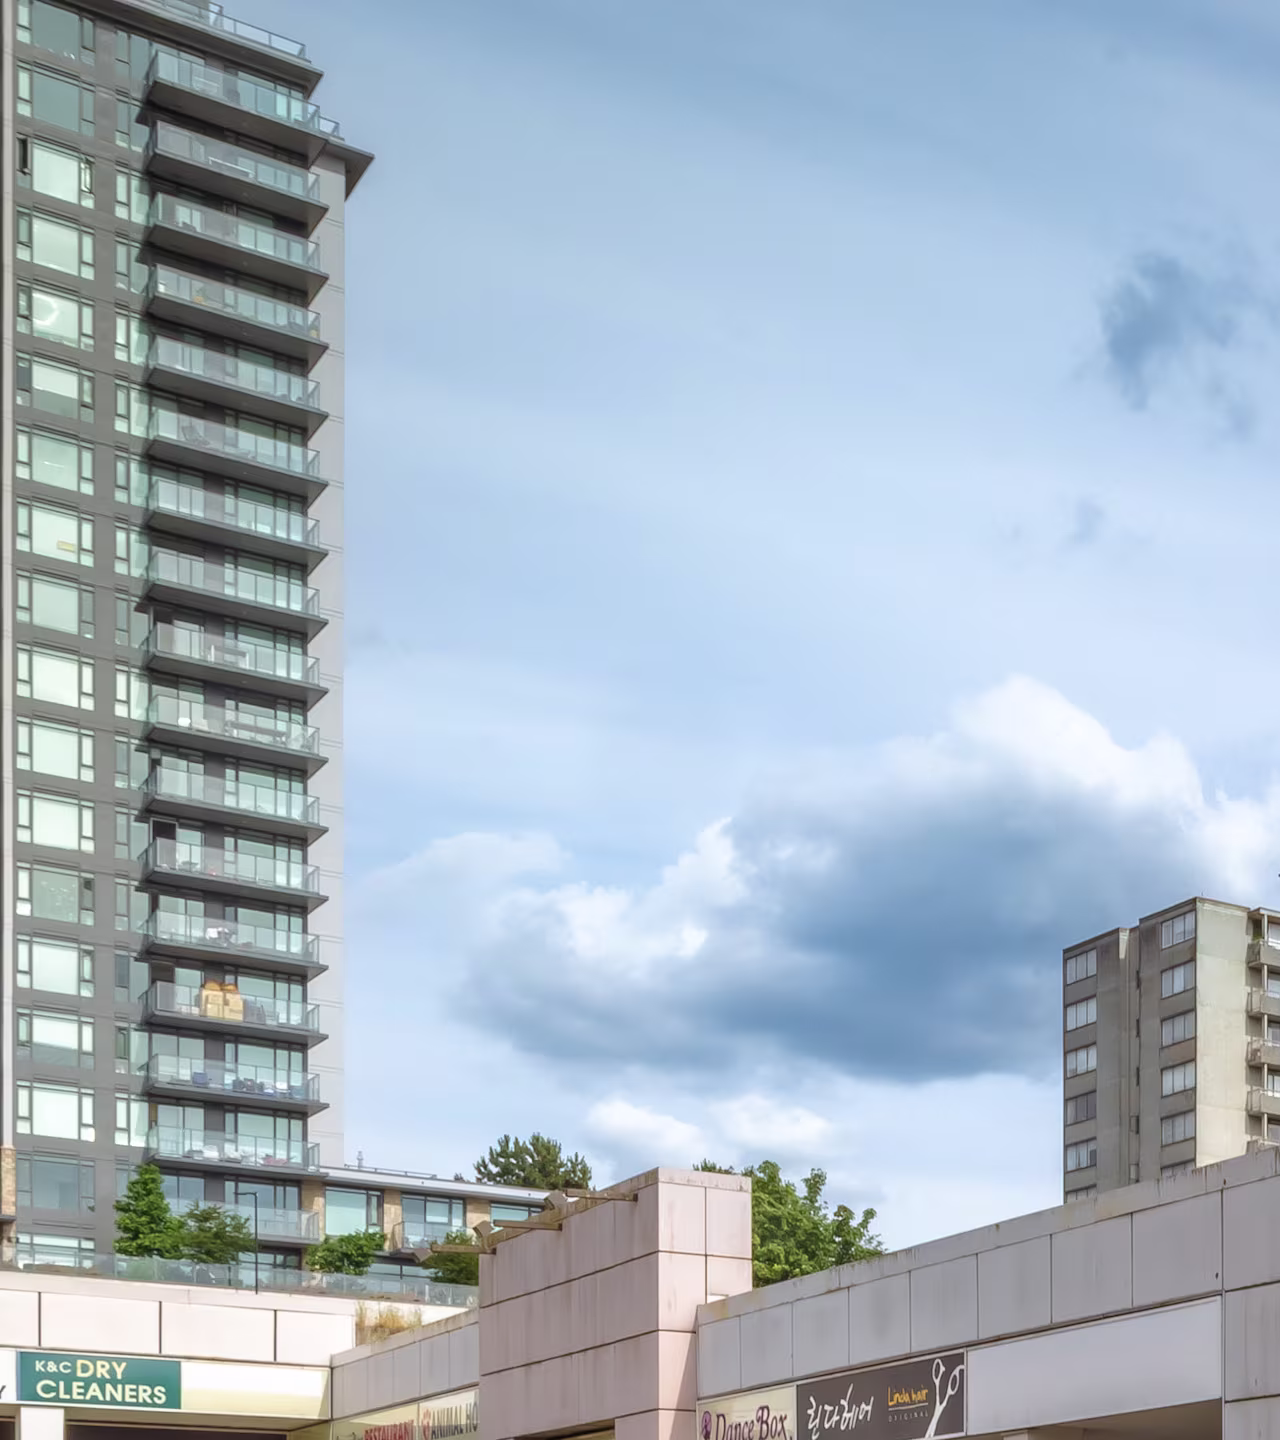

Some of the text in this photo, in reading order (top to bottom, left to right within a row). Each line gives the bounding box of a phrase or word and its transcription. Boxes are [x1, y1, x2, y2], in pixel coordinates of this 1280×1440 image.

[35, 1359, 127, 1379] K&C DRY
[36, 1380, 167, 1405] CLEANERS
